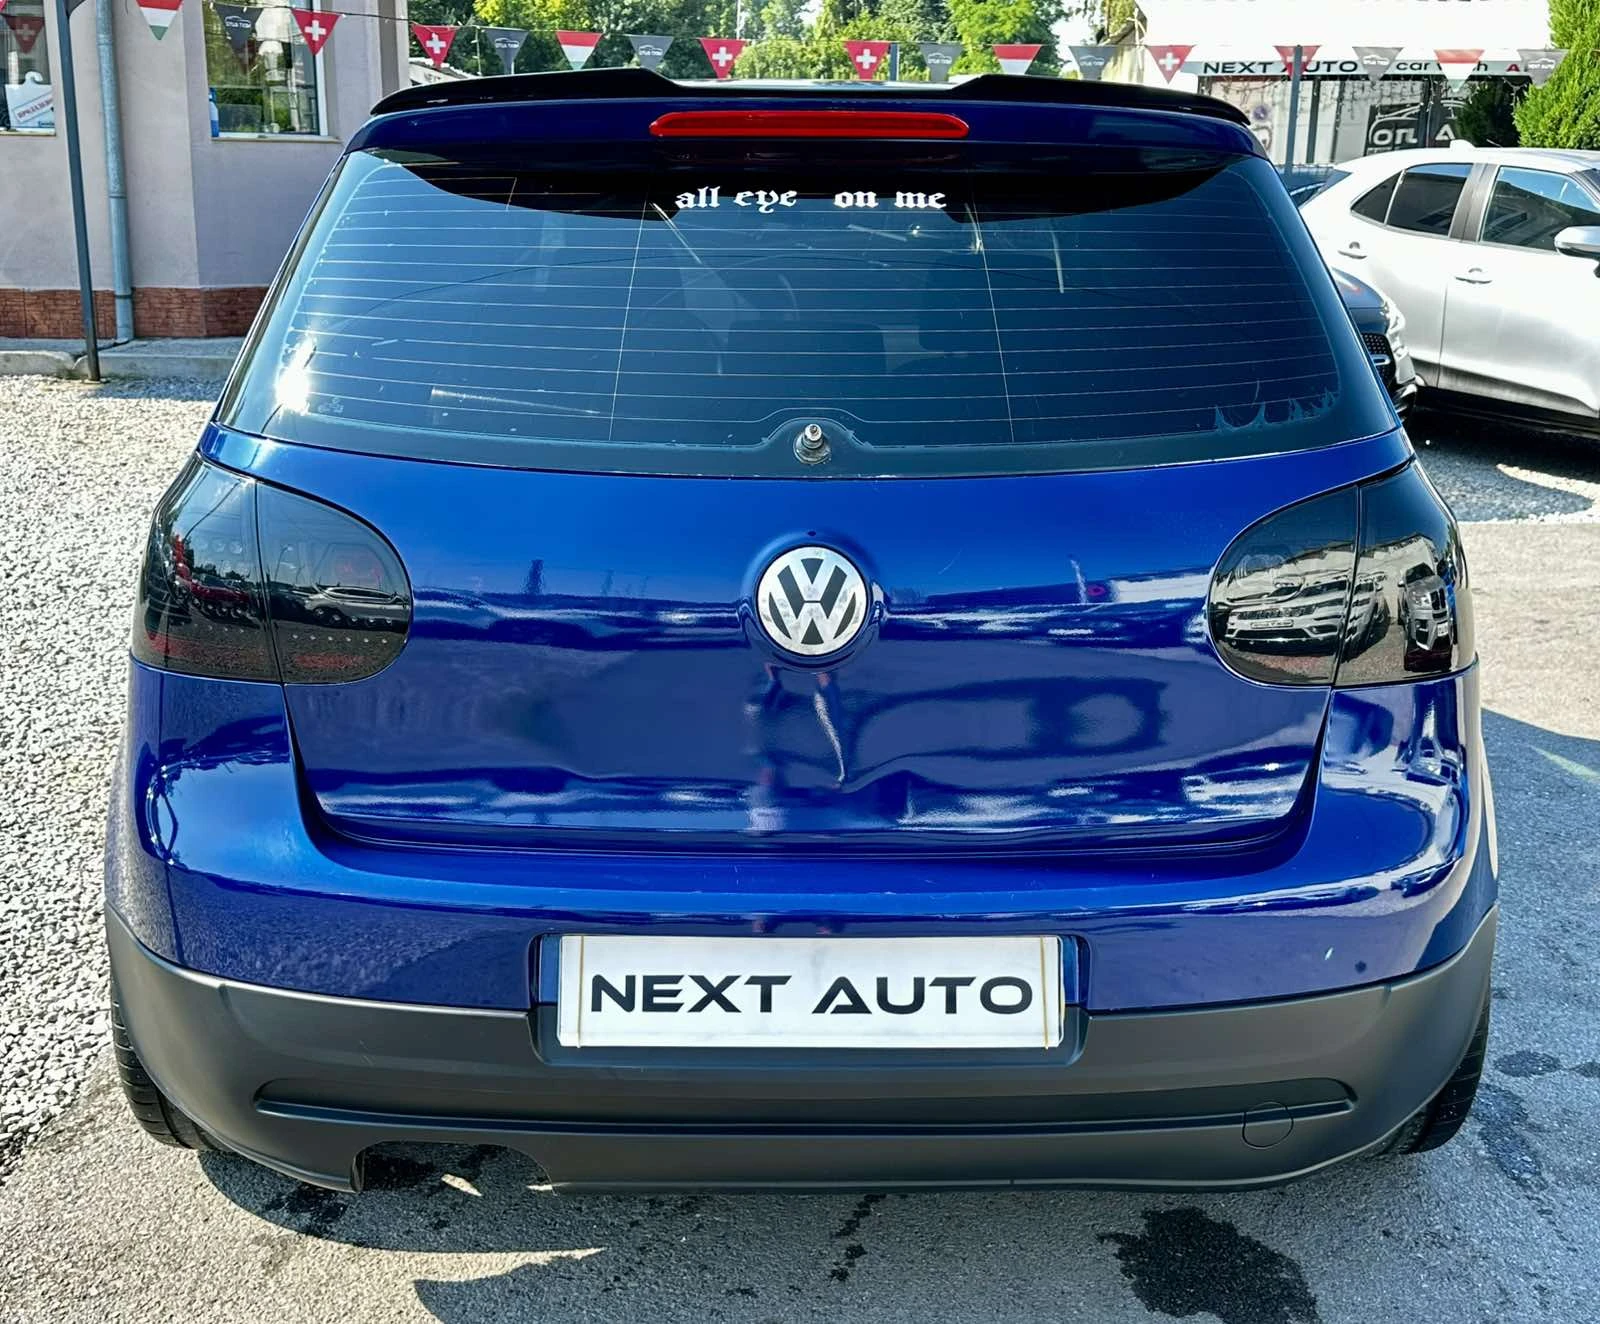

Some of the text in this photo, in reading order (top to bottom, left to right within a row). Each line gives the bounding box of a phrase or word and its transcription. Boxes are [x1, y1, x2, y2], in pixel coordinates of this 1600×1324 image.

[1203, 61, 1273, 74] NEXT
[1281, 61, 1358, 74] UTO
[1395, 61, 1430, 71] car
[675, 185, 947, 214] all eye on me
[590, 974, 1033, 1015] NEXT AUTO
